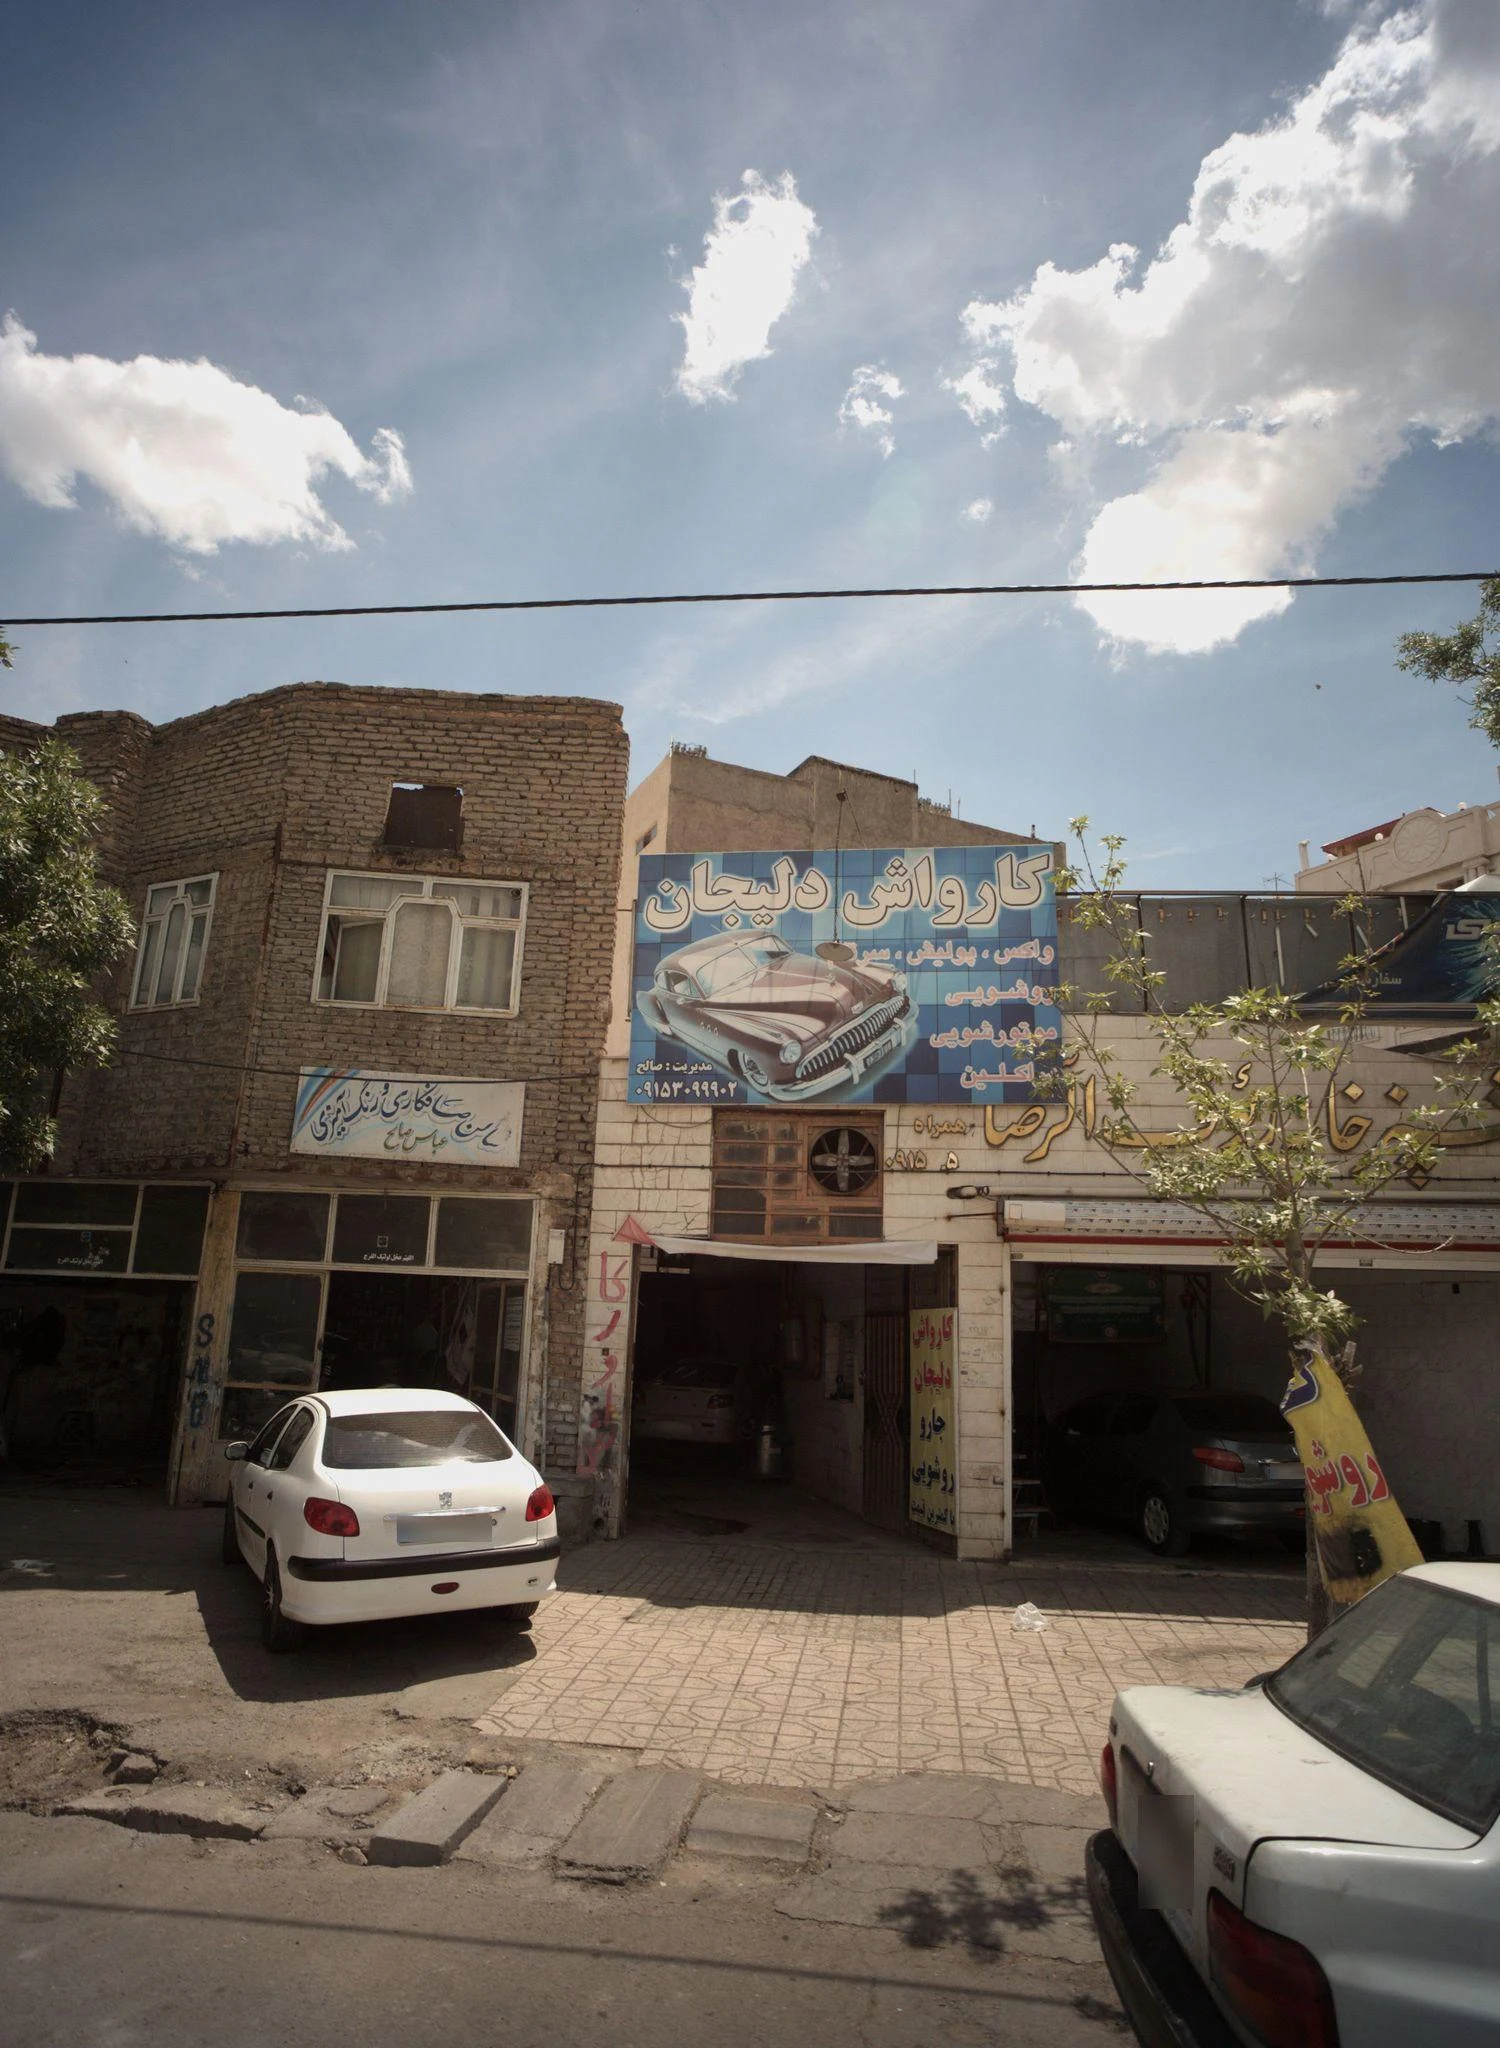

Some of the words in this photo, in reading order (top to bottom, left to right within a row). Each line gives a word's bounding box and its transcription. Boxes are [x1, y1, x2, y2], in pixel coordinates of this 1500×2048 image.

[644, 856, 829, 931] دلیجان
[842, 852, 1052, 927] کارواش
[636, 1059, 663, 1075] صالح
[914, 1114, 966, 1139] همراه
[912, 1313, 954, 1349] کارواش
[914, 1361, 952, 1395] دلیجان
[920, 1407, 946, 1443] جارو
